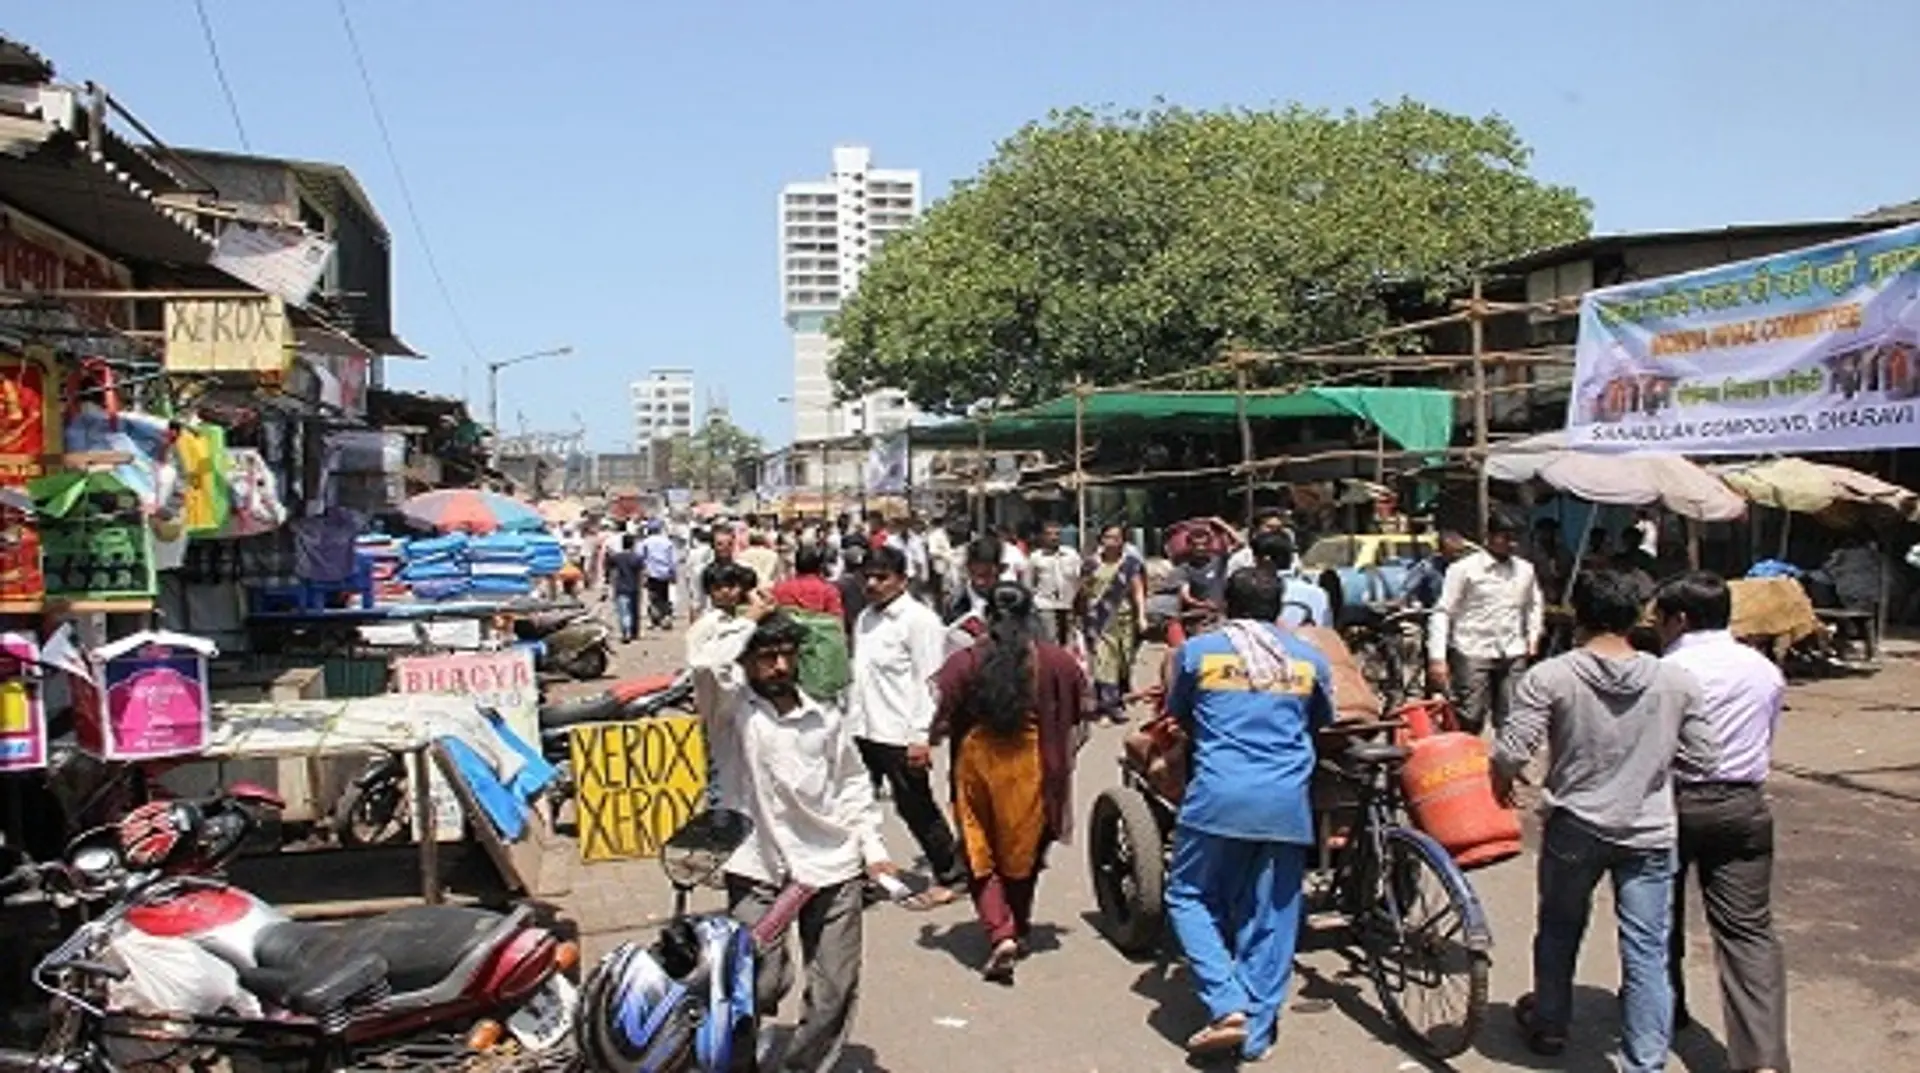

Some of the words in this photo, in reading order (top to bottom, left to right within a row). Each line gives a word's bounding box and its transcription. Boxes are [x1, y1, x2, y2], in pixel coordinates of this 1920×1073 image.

[169, 299, 277, 342] XEROX
[404, 661, 529, 693] BHAGYA
[571, 719, 699, 789] XEROX
